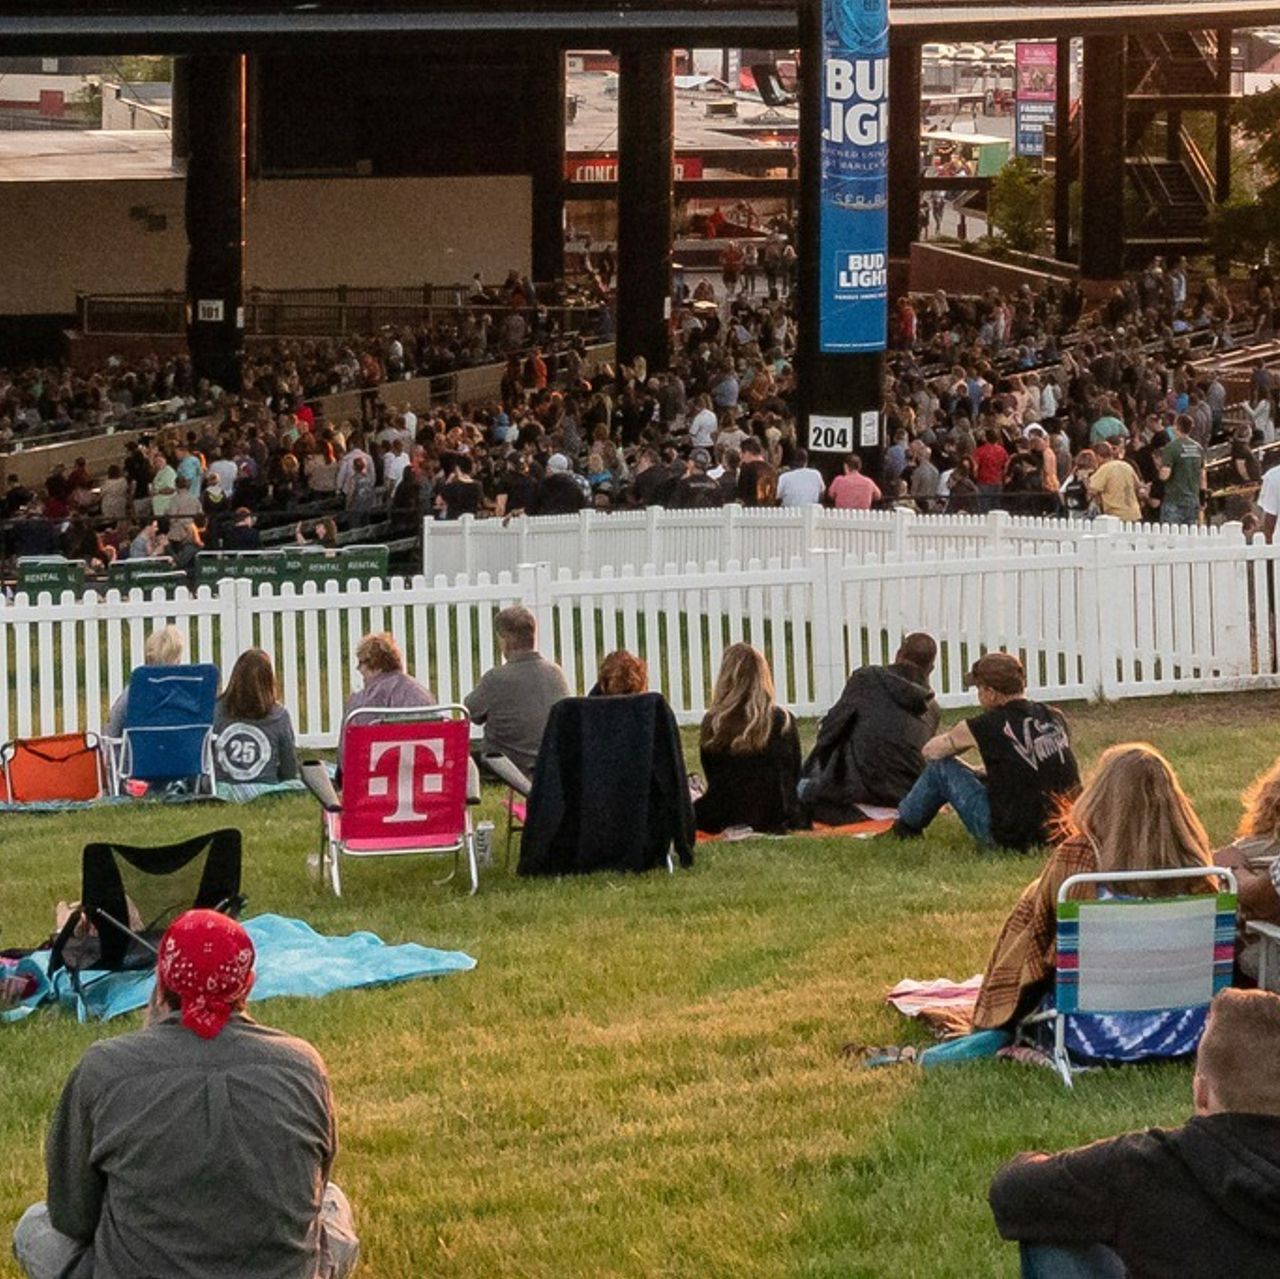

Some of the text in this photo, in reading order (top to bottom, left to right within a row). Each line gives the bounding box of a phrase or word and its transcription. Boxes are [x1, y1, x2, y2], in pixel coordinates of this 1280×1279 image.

[848, 253, 885, 271] BUD
[812, 426, 848, 448] 204
[244, 566, 278, 575] RENTAL
[347, 561, 379, 569] RENTAL
[24, 572, 60, 583] RENTAL
[230, 740, 256, 763] 25
